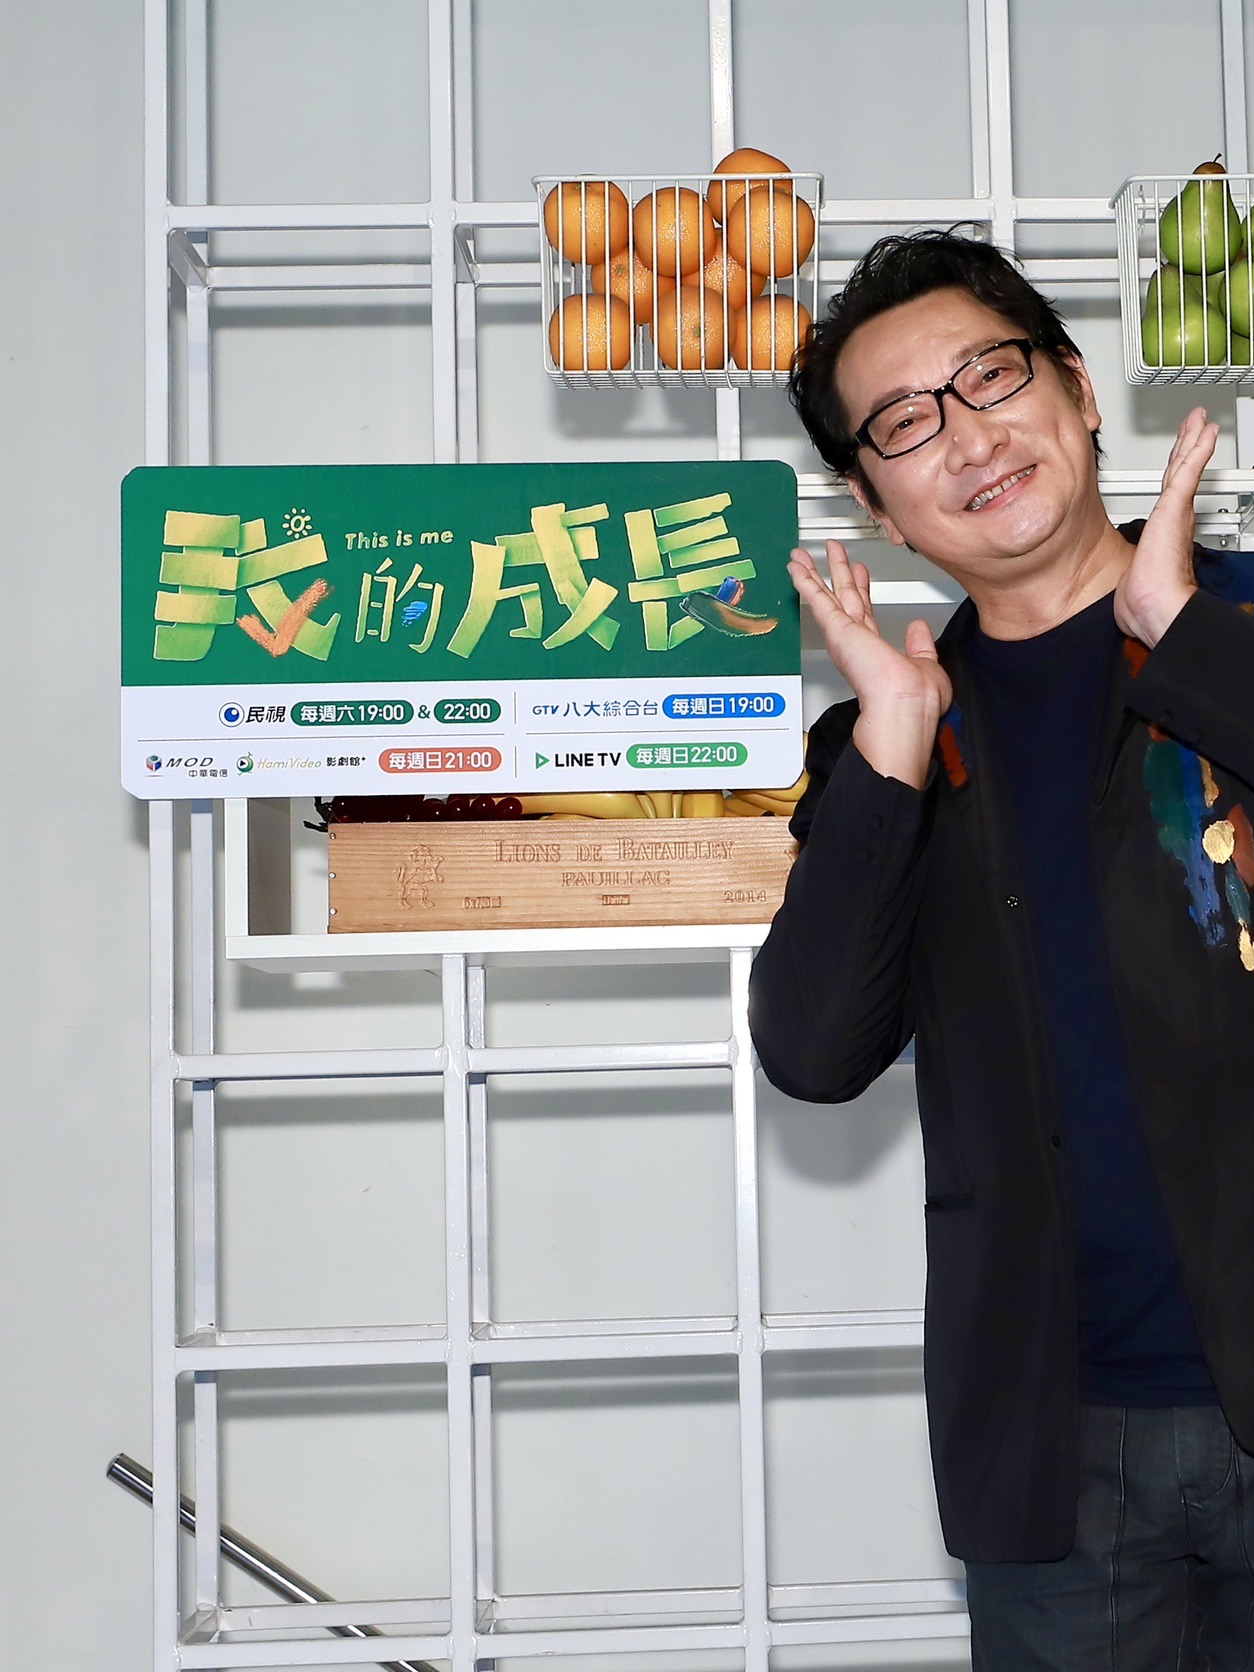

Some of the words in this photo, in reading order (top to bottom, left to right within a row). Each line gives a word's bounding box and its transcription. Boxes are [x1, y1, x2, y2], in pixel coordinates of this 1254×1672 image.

[345, 532, 388, 550] This
[395, 529, 413, 547] is
[420, 530, 454, 545] me
[245, 705, 286, 723] 民視
[418, 705, 431, 720] &
[443, 703, 490, 719] 22:00
[532, 704, 559, 716] GTV
[563, 699, 658, 717] 八大綜合台
[165, 757, 214, 768] MOD
[554, 753, 594, 767] LINE
[598, 752, 622, 766] TV
[494, 840, 561, 863] LIONS
[561, 870, 671, 887] PAUILLAC
[724, 890, 767, 904] 2014
